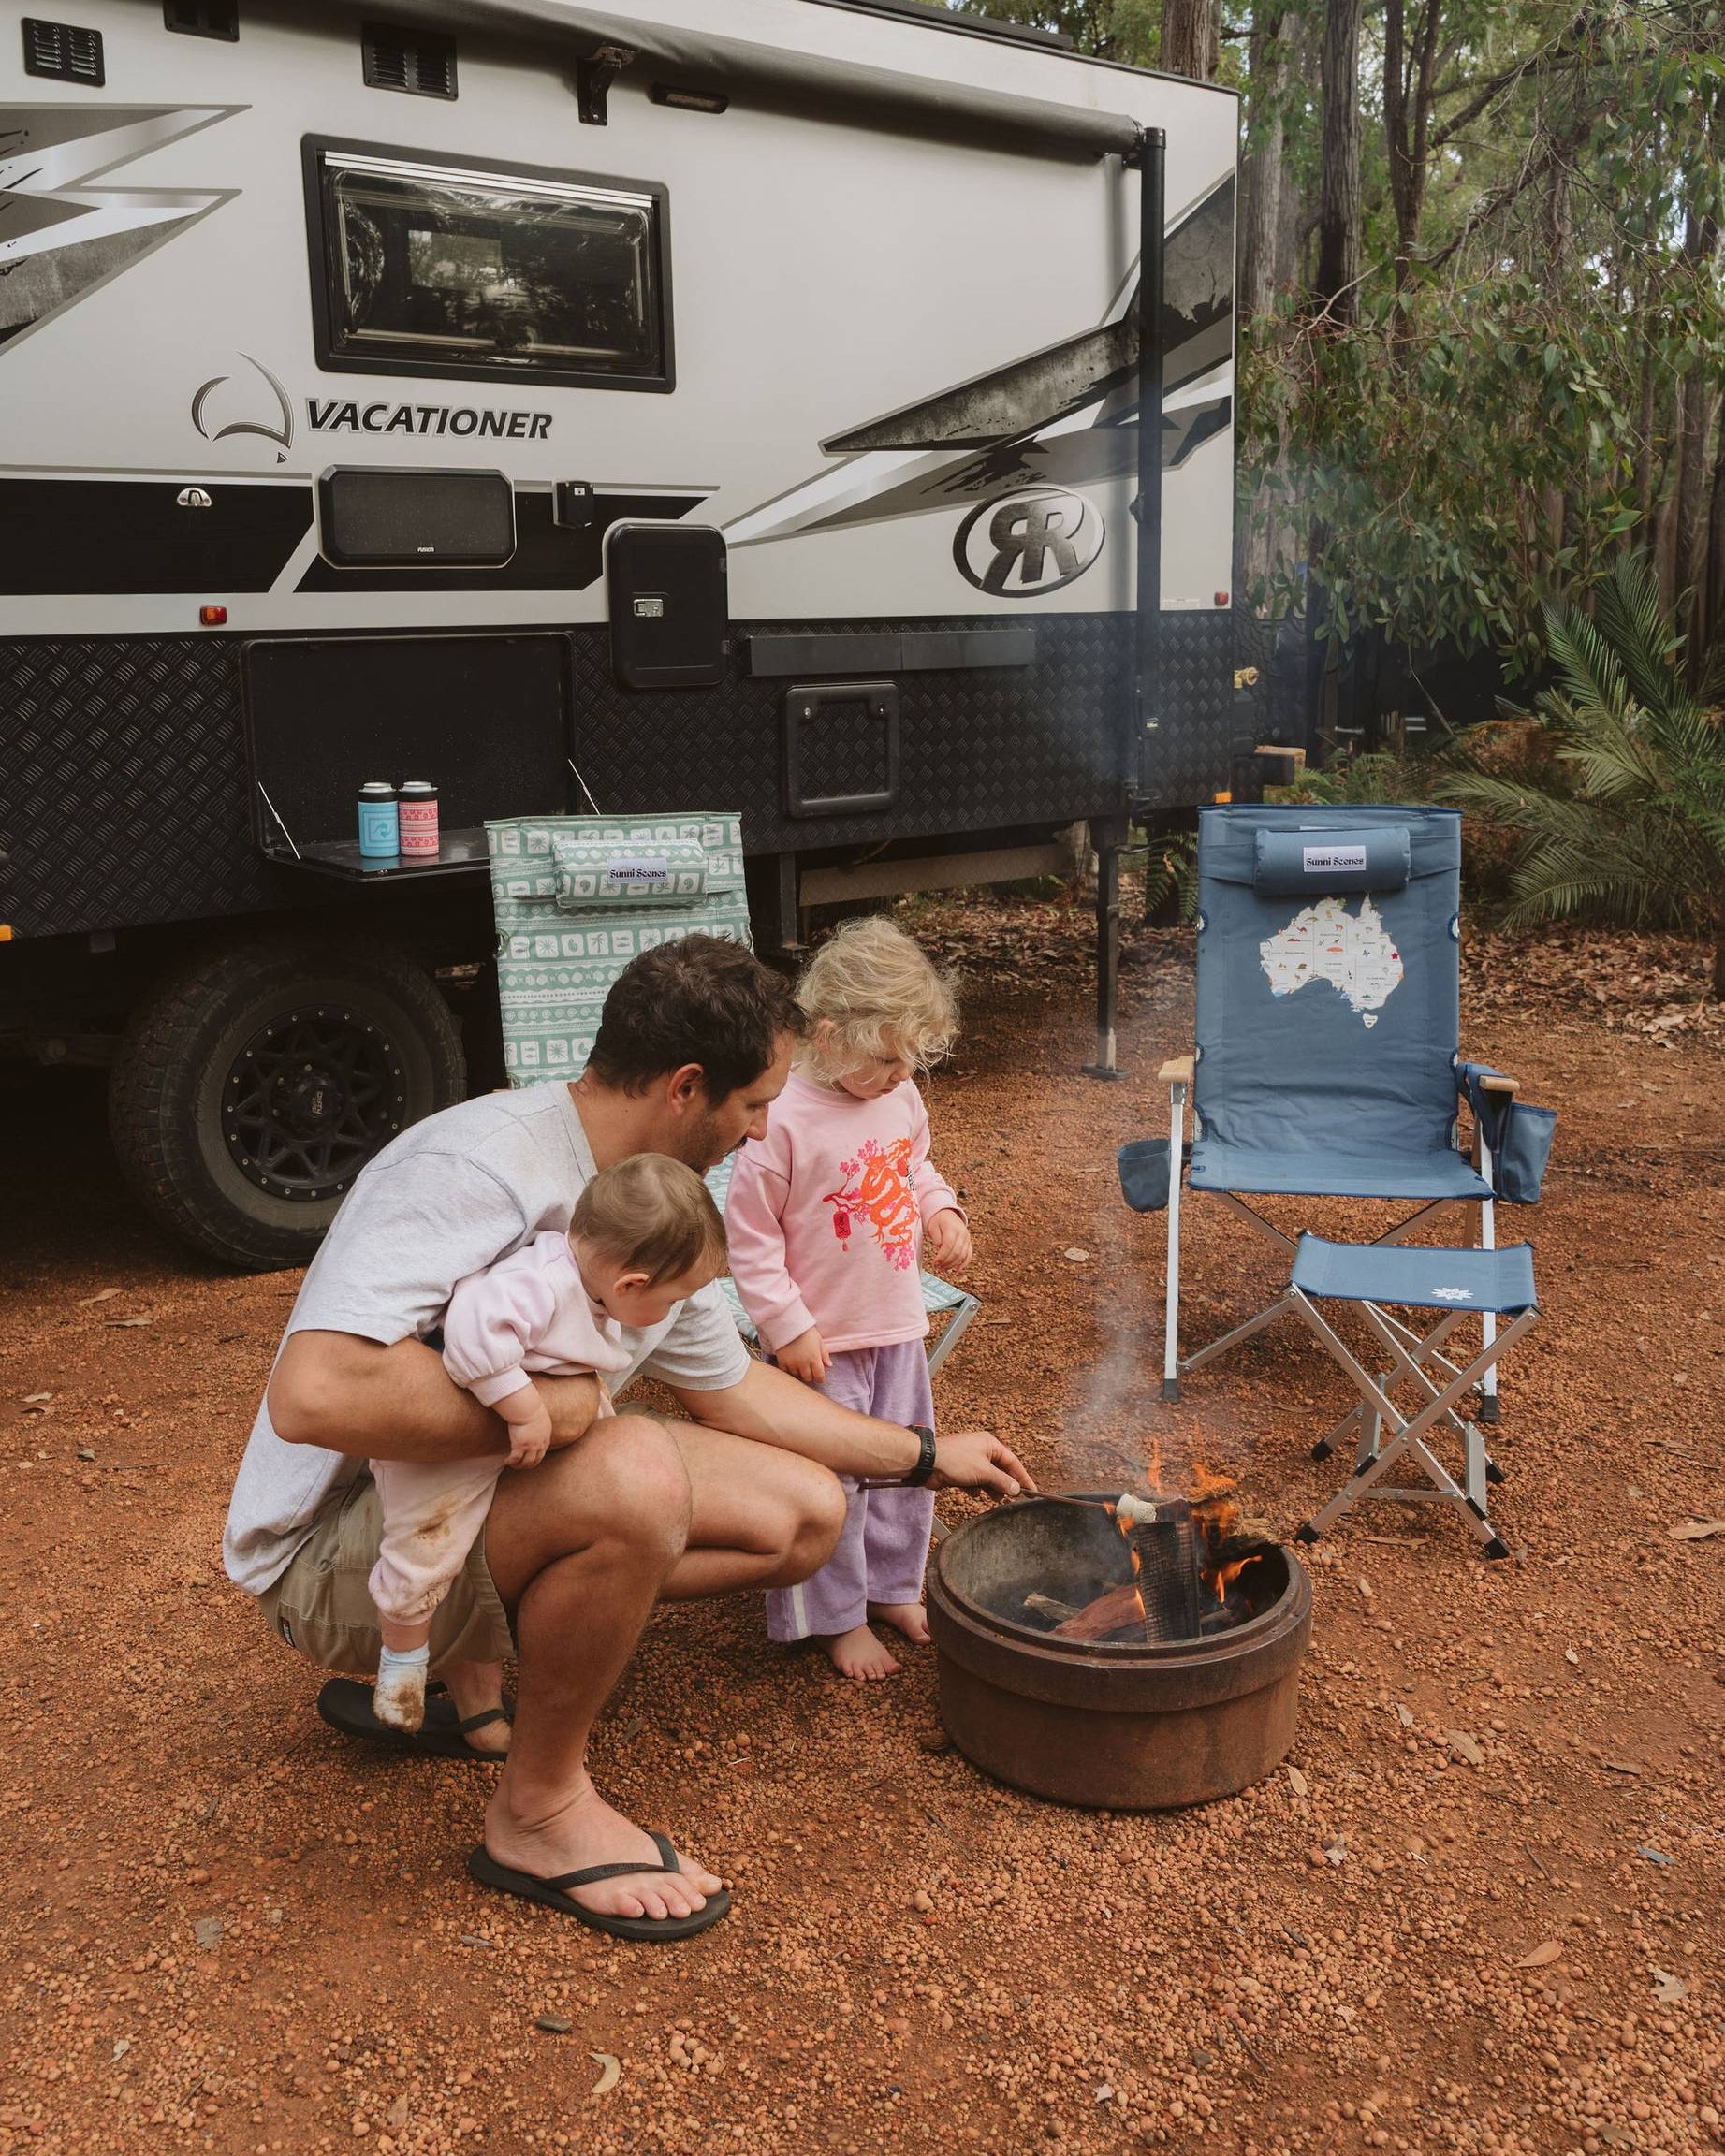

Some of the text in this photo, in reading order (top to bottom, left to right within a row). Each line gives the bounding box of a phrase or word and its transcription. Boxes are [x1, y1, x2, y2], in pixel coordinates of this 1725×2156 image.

[307, 400, 553, 440] VACATIONER
[1306, 856, 1364, 866] Sunni Scenes
[610, 868, 667, 878] Sunni Scenes
